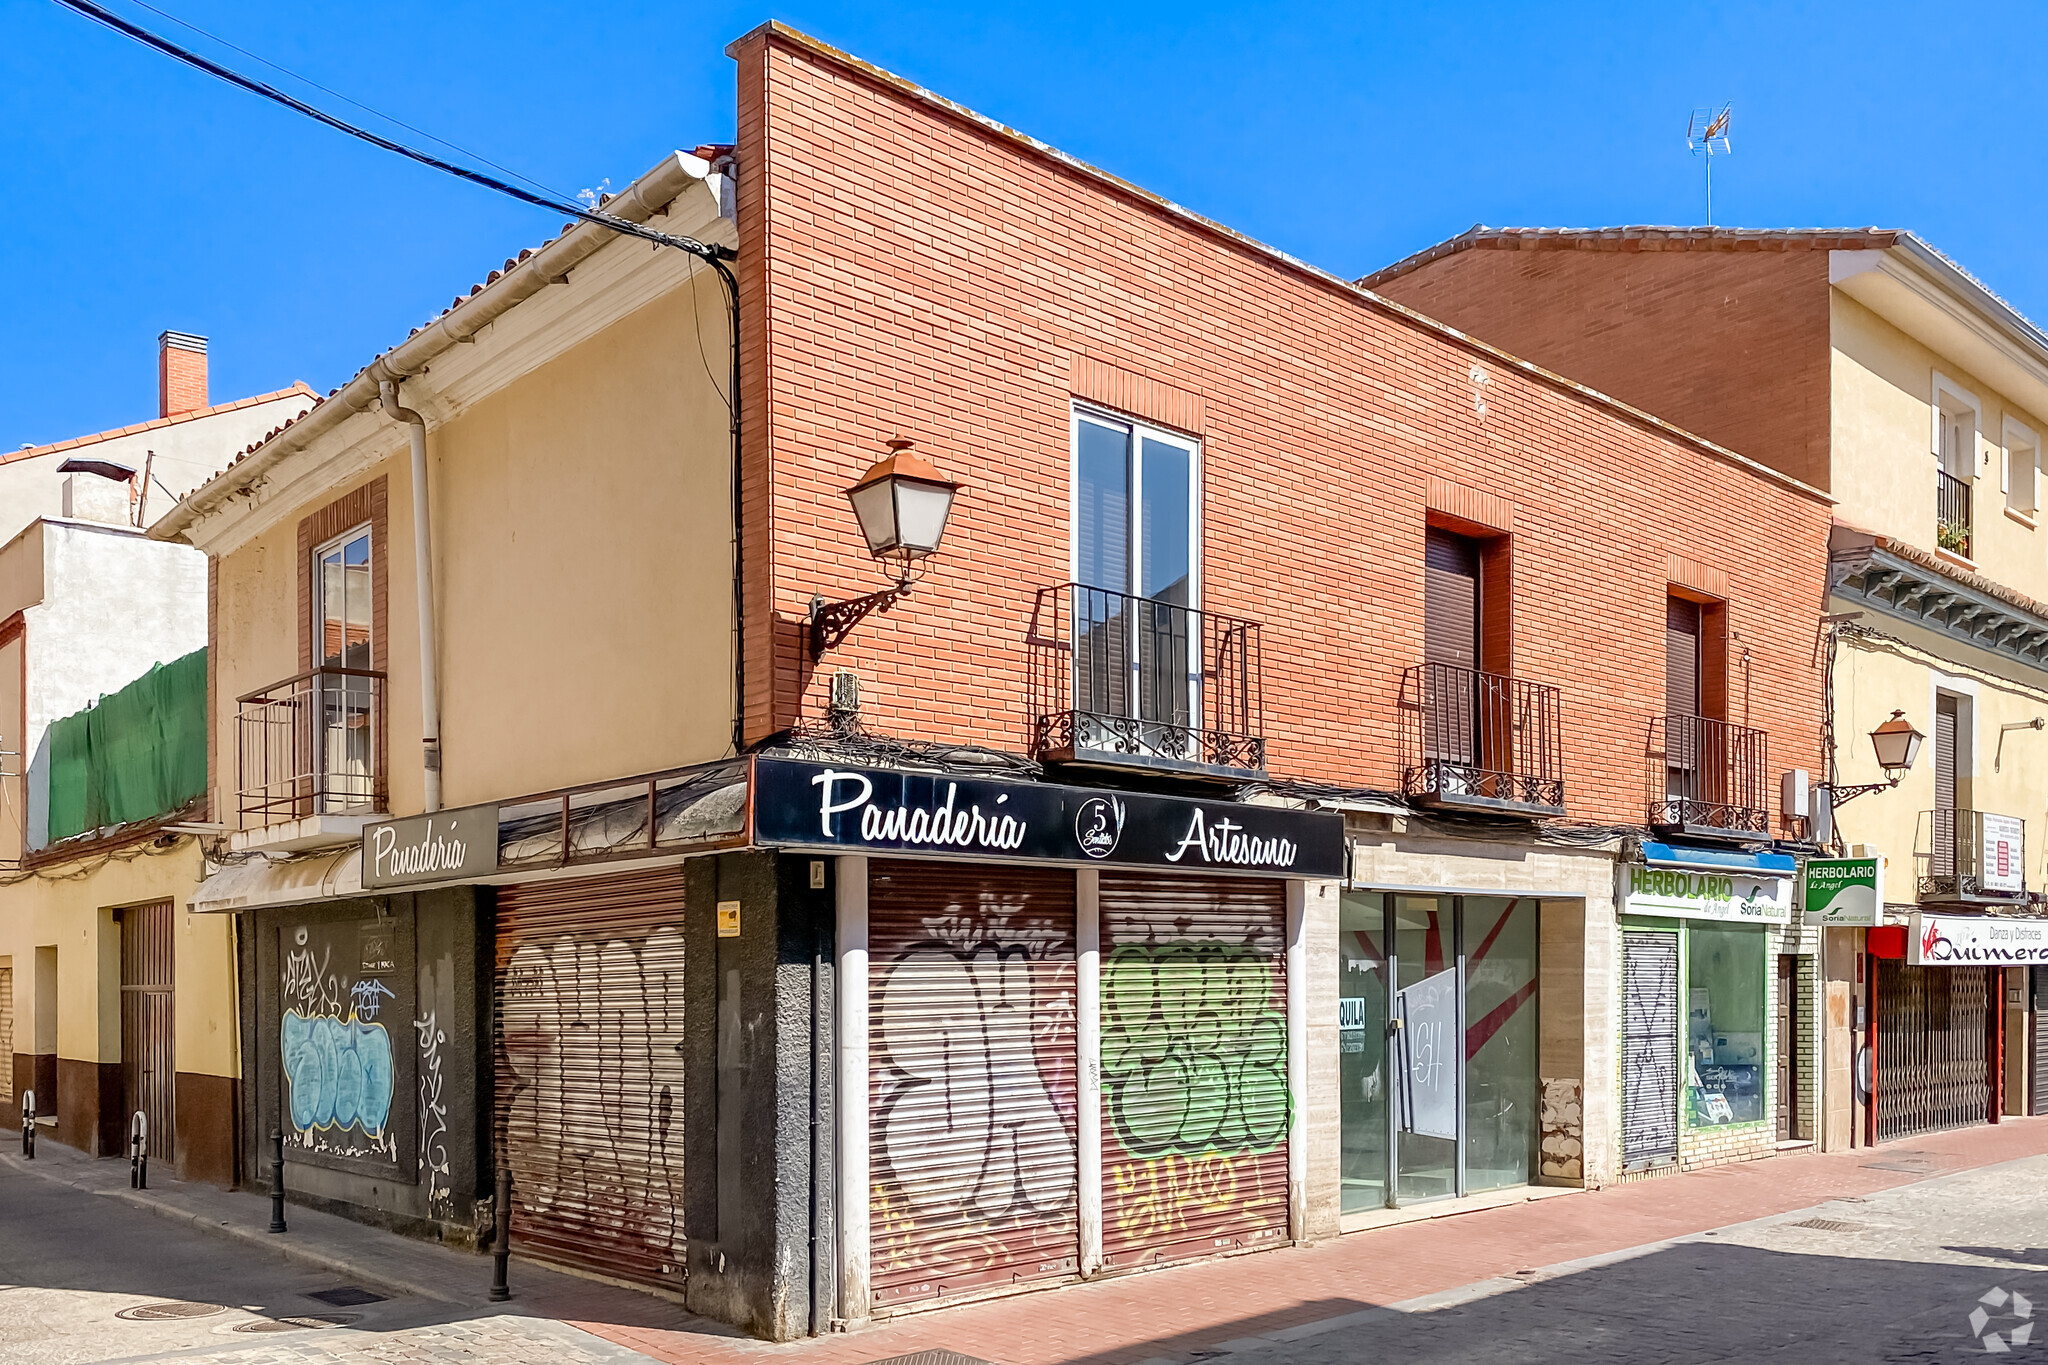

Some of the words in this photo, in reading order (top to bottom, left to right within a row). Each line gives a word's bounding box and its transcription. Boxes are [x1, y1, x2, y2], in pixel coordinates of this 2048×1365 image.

[811, 769, 1027, 850] Panadería
[1094, 804, 1106, 831] 5
[372, 819, 467, 878] Panadería
[1164, 807, 1297, 867] Artesana
[1630, 868, 1734, 902] HERBOLARIO
[1808, 866, 1875, 879] HERBOLARIO
[1989, 926, 2008, 939] Danza
[2010, 930, 2014, 943] y
[2015, 927, 2042, 940] Disfraces
